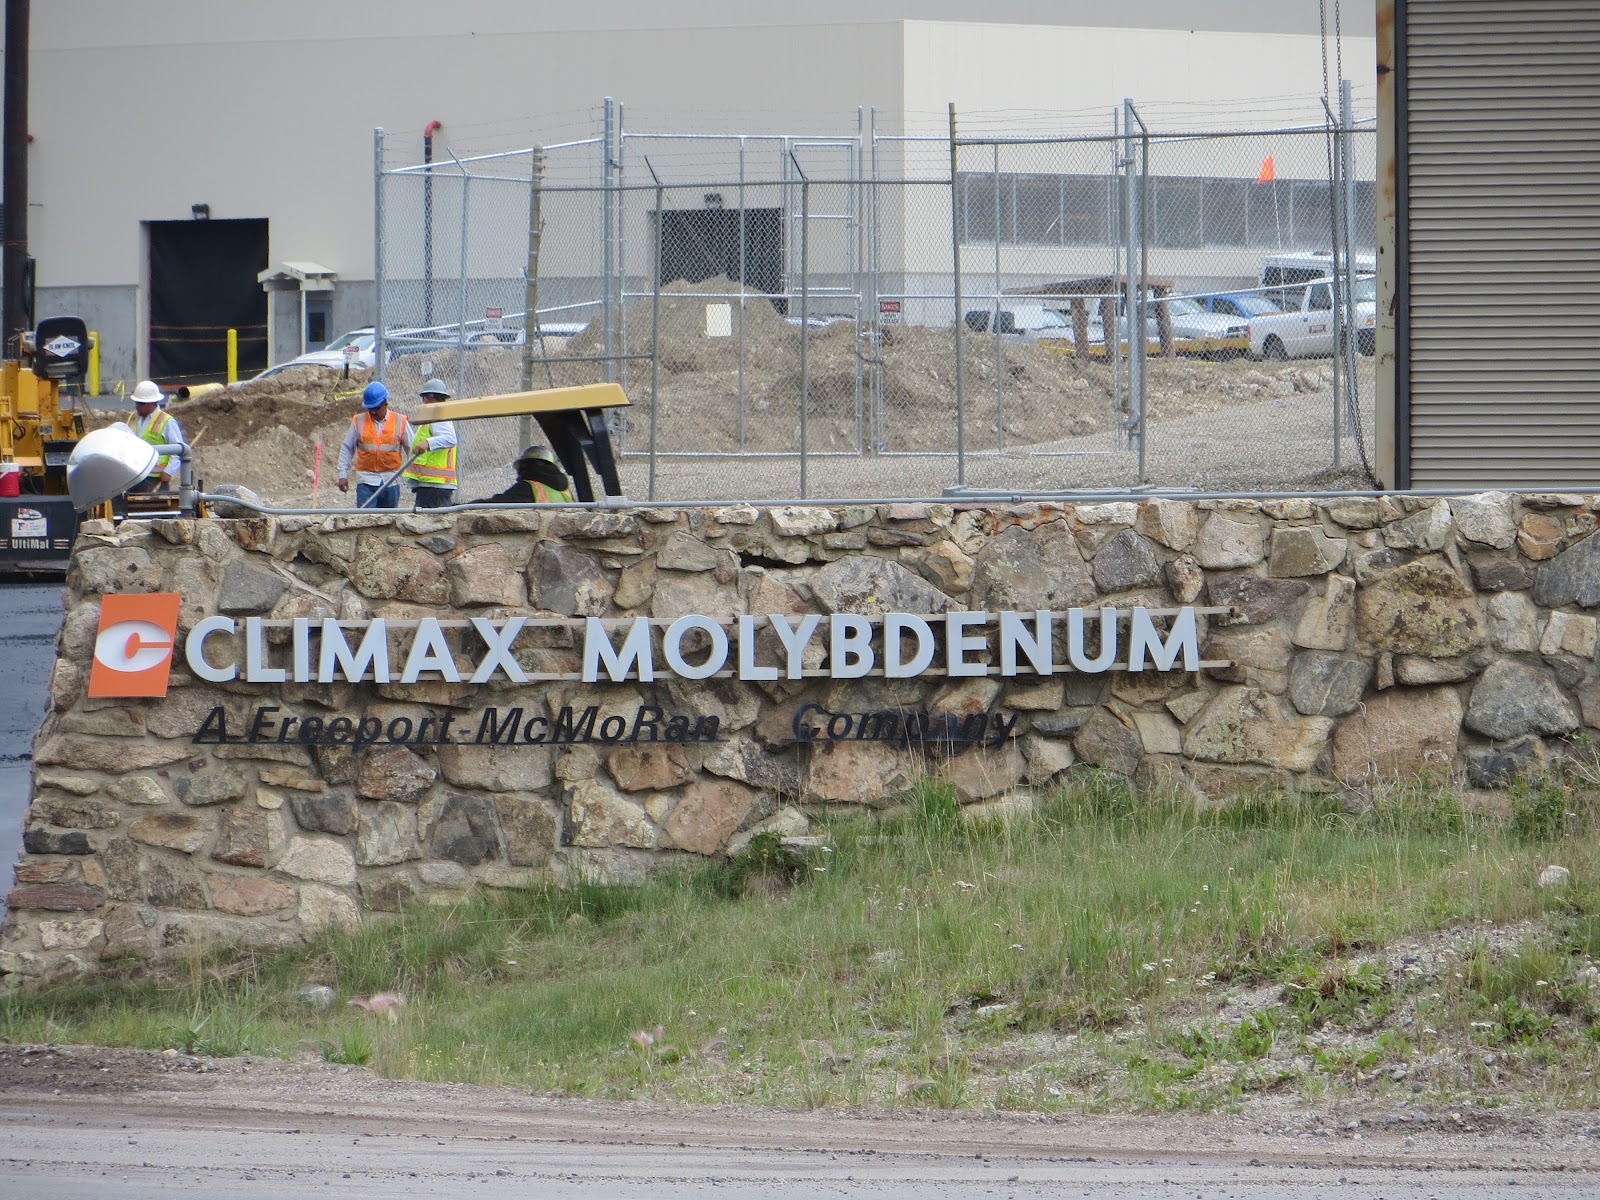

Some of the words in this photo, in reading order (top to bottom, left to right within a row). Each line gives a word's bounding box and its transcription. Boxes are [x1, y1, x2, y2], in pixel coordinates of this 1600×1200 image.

[48, 342, 76, 351] BLAW-KNOX
[185, 616, 530, 684] CLIMAX
[582, 606, 1200, 683] MOLYBDENUM
[192, 706, 228, 744] A
[247, 705, 721, 752] Freeport-McMoRan
[792, 703, 1019, 748] Company
